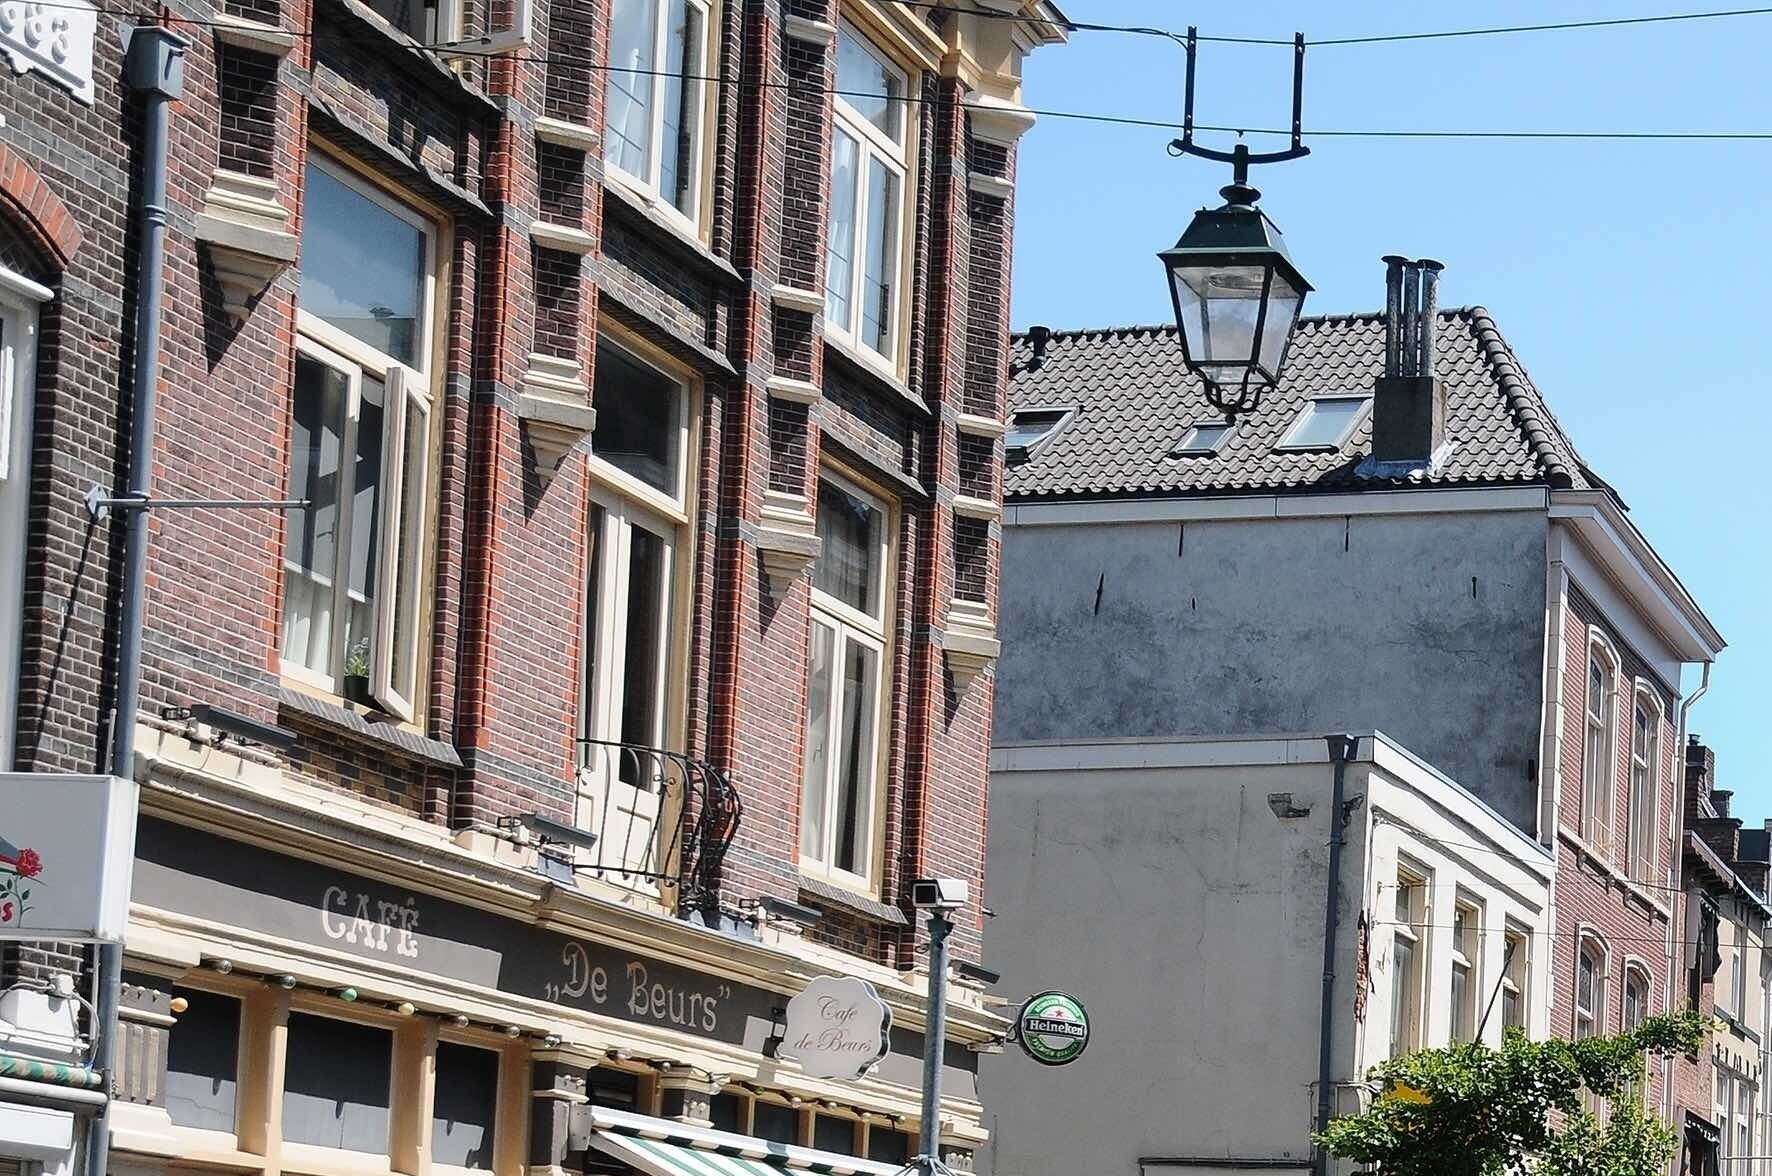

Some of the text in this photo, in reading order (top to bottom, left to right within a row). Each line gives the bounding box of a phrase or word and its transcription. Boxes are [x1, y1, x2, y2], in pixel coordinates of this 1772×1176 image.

[322, 886, 420, 958] CAFÉ
[1029, 1019, 1083, 1036] Heineken
[794, 1028, 872, 1052] de Beurs
